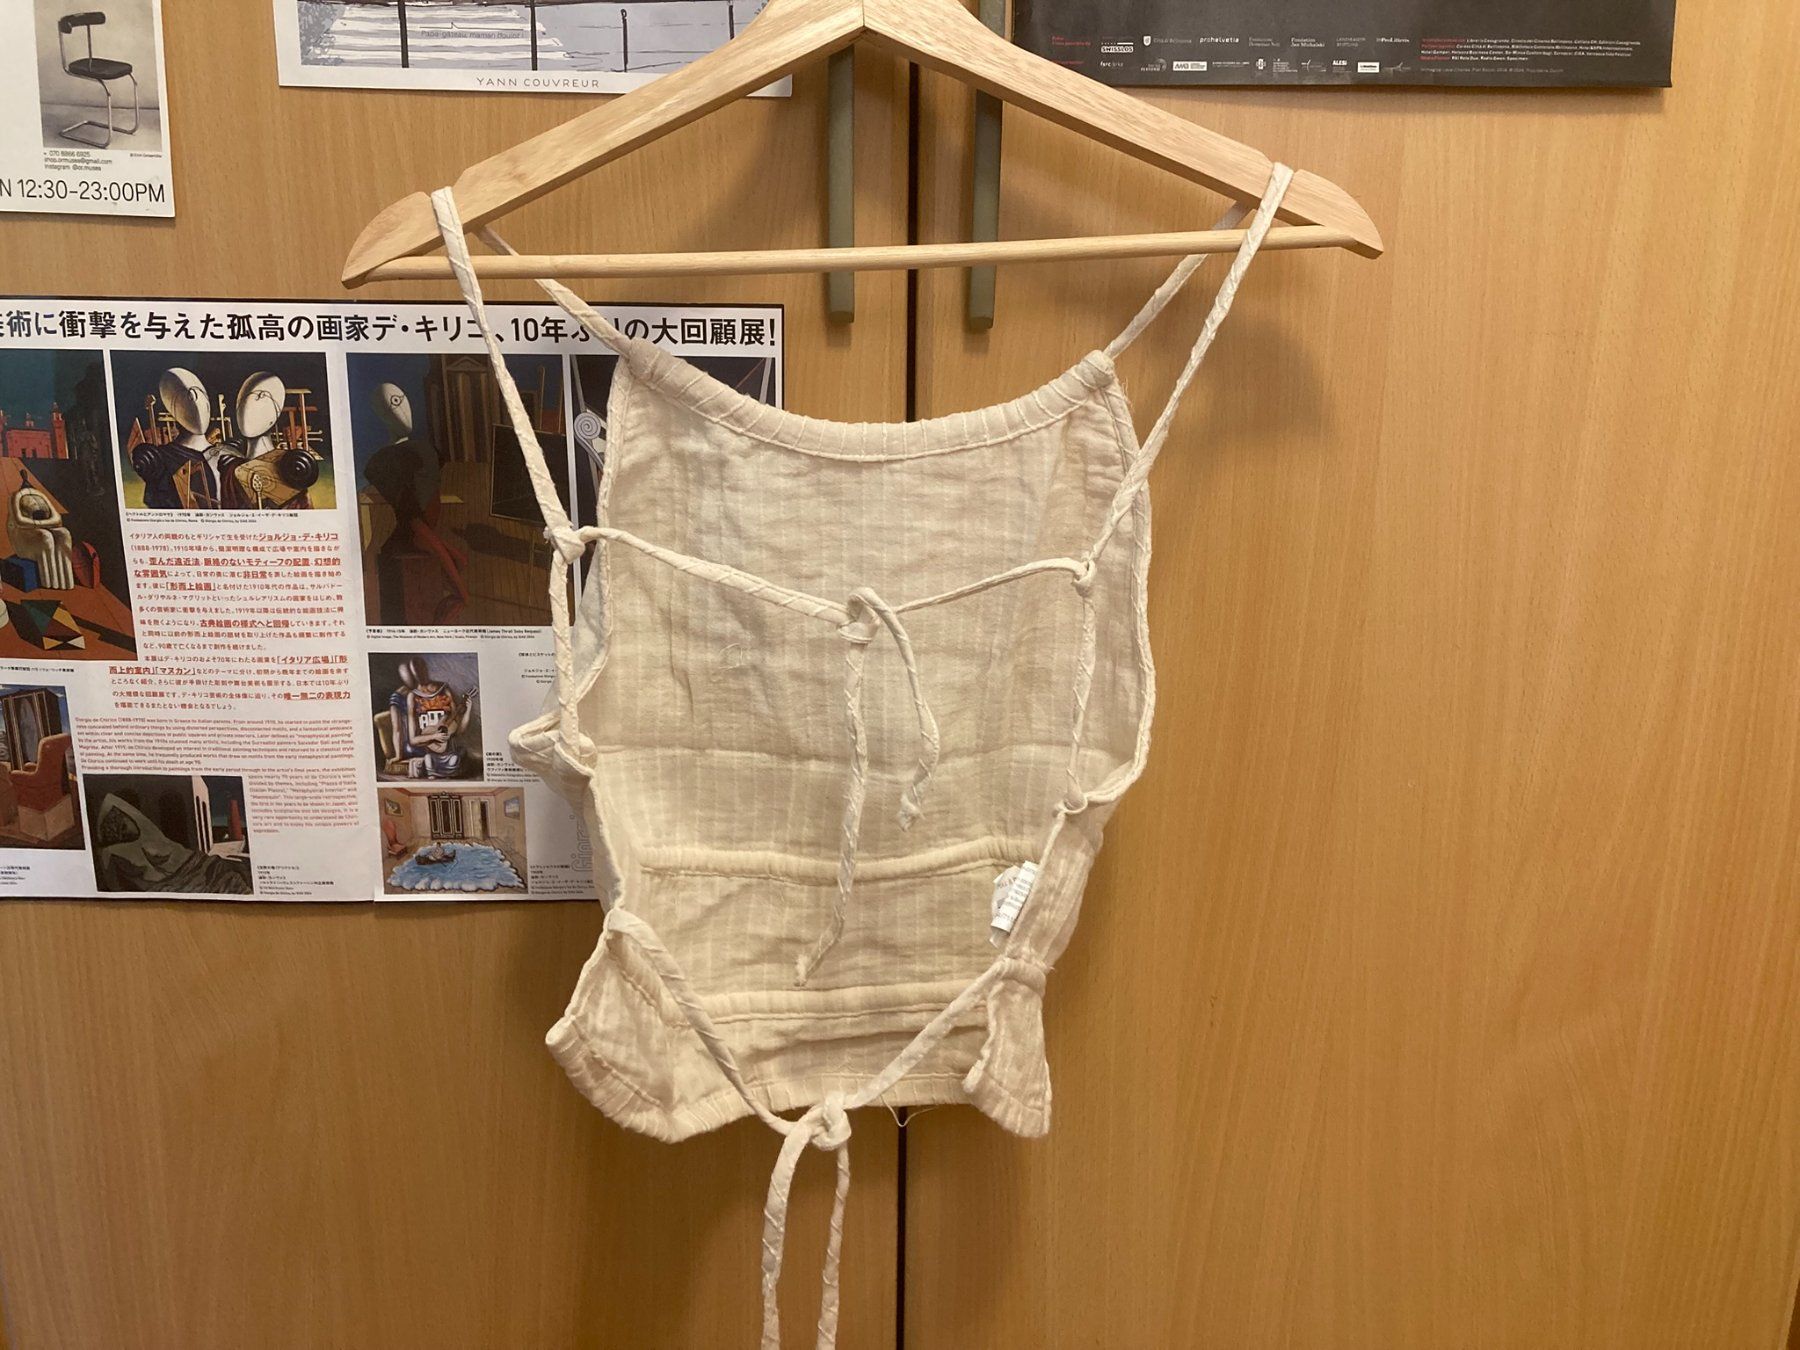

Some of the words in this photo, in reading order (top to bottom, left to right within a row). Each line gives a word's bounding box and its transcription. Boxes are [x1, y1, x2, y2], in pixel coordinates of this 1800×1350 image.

[476, 77, 518, 87] YANN
[523, 78, 600, 88] COUVREUR
[16, 178, 165, 203] 12:30-23:00PM
